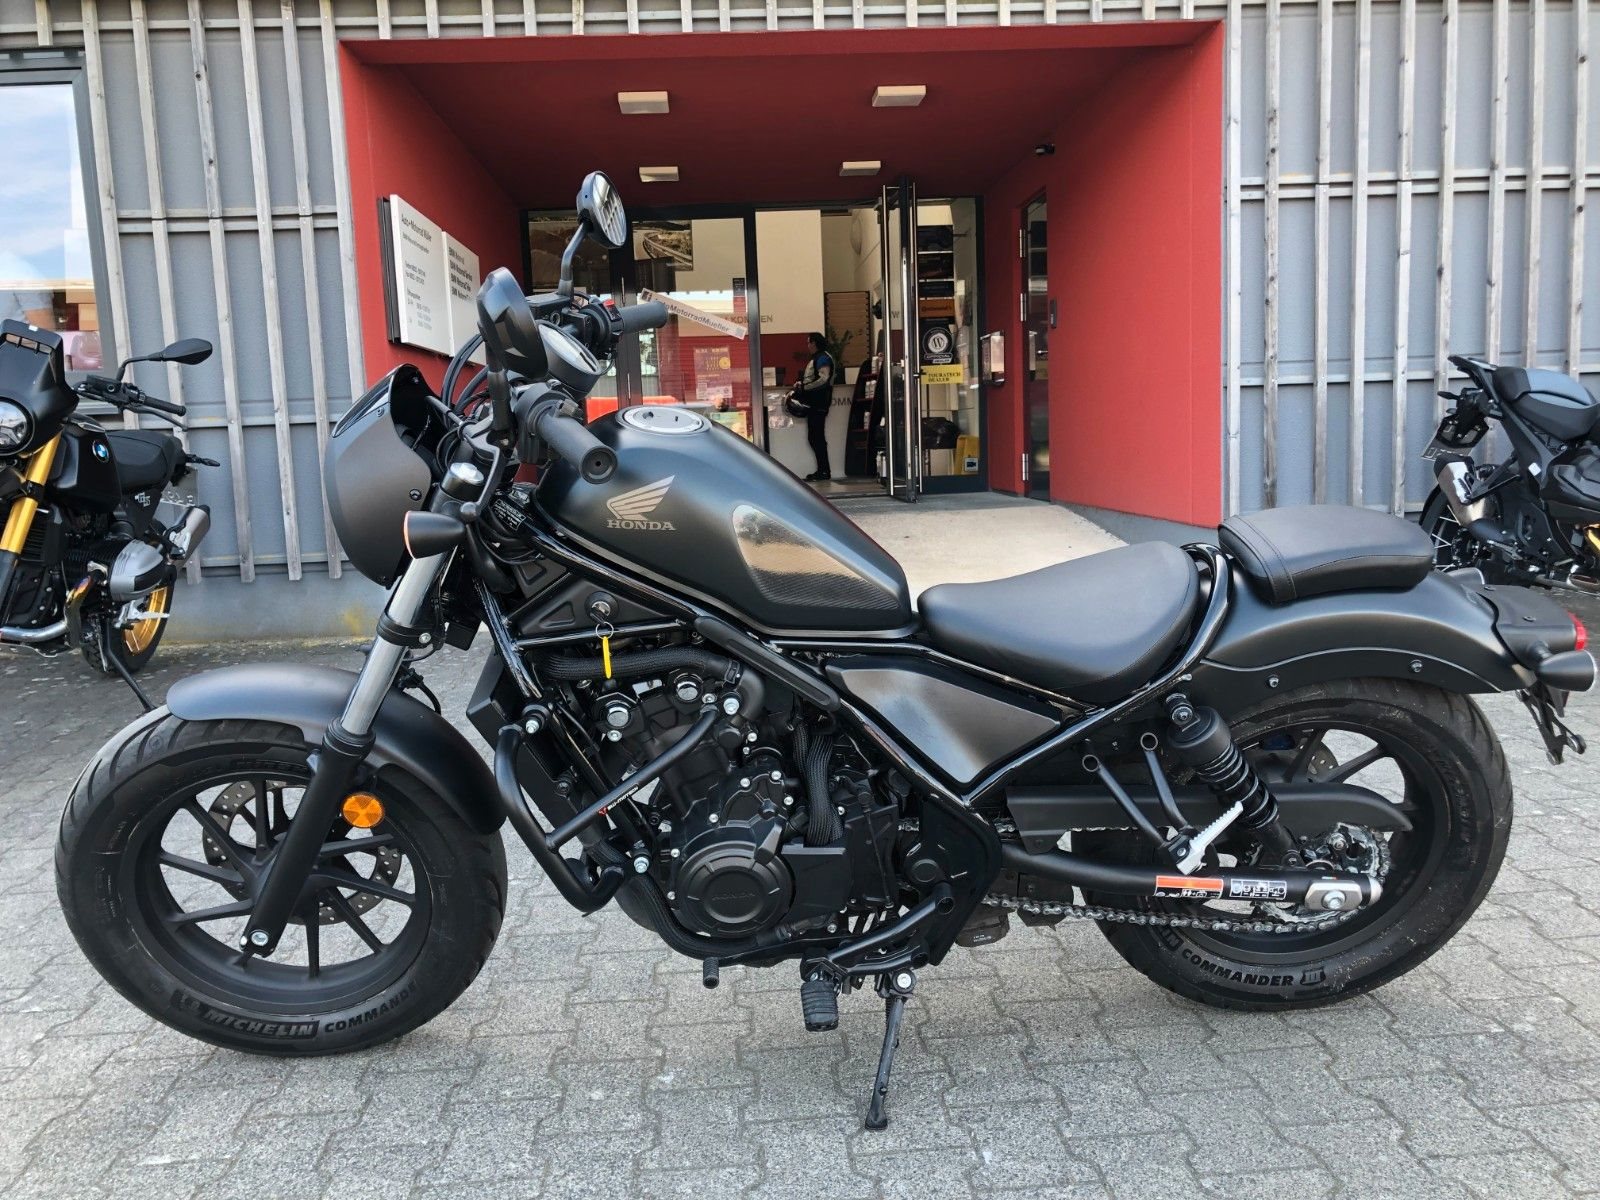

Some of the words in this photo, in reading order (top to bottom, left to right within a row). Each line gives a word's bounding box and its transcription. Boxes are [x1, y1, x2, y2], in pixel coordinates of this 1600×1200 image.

[606, 519, 677, 531] HONDA
[1181, 948, 1294, 987] COMMANDER
[205, 1008, 315, 1038] MICHELIN
